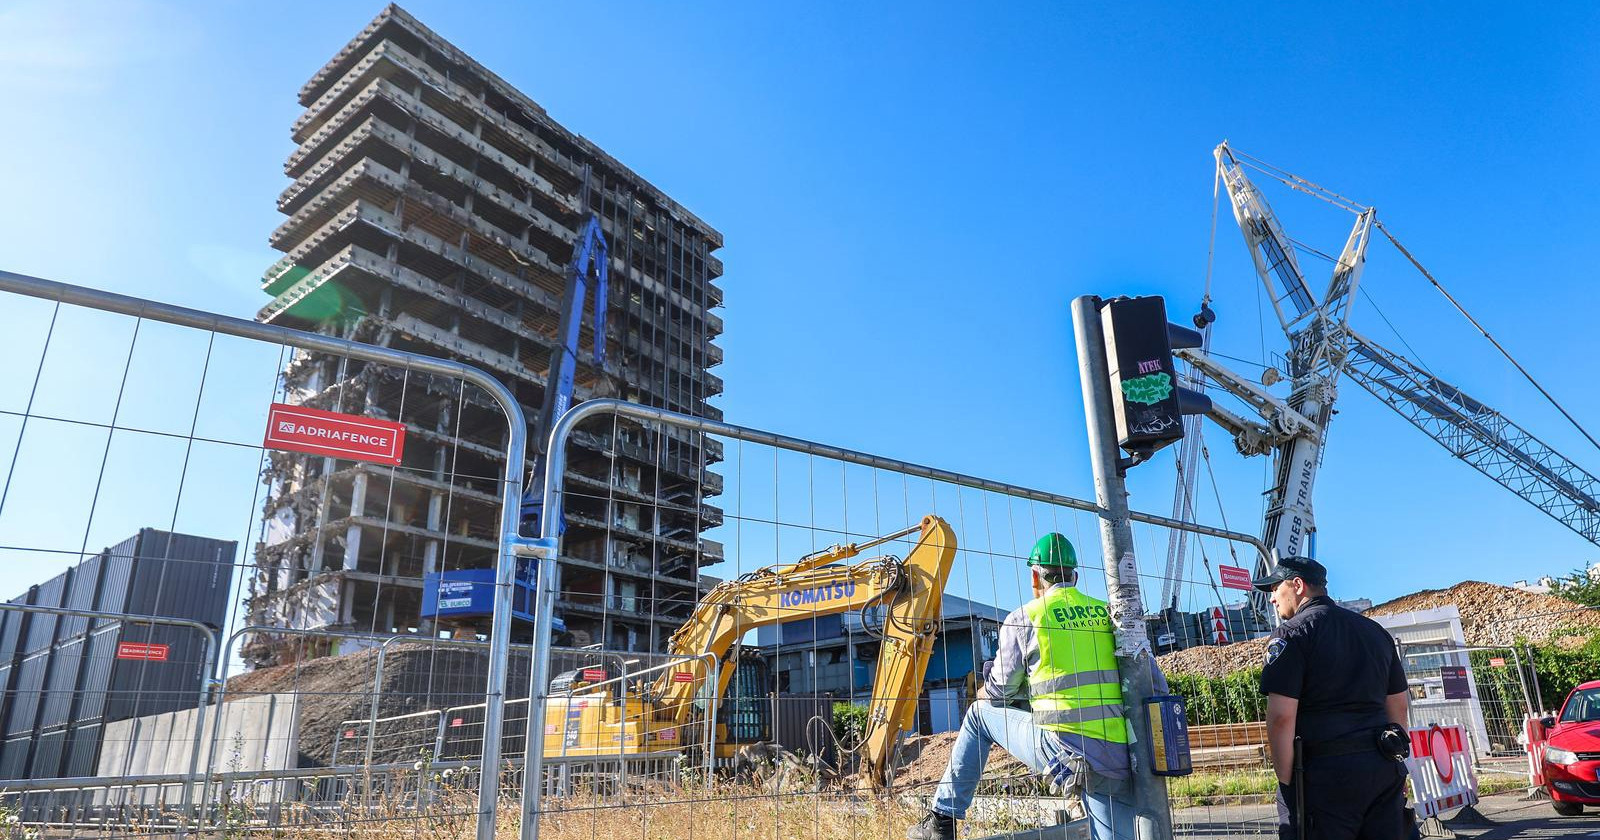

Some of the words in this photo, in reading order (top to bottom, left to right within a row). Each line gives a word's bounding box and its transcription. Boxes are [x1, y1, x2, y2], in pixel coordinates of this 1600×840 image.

[296, 425, 388, 447] ADRIAFENCE
[1287, 515, 1302, 556] GREB
[1296, 459, 1312, 507] TRANS
[780, 580, 855, 607] KOMATSU
[1053, 605, 1108, 623] EURCO
[1060, 618, 1108, 630] VINKOVC
